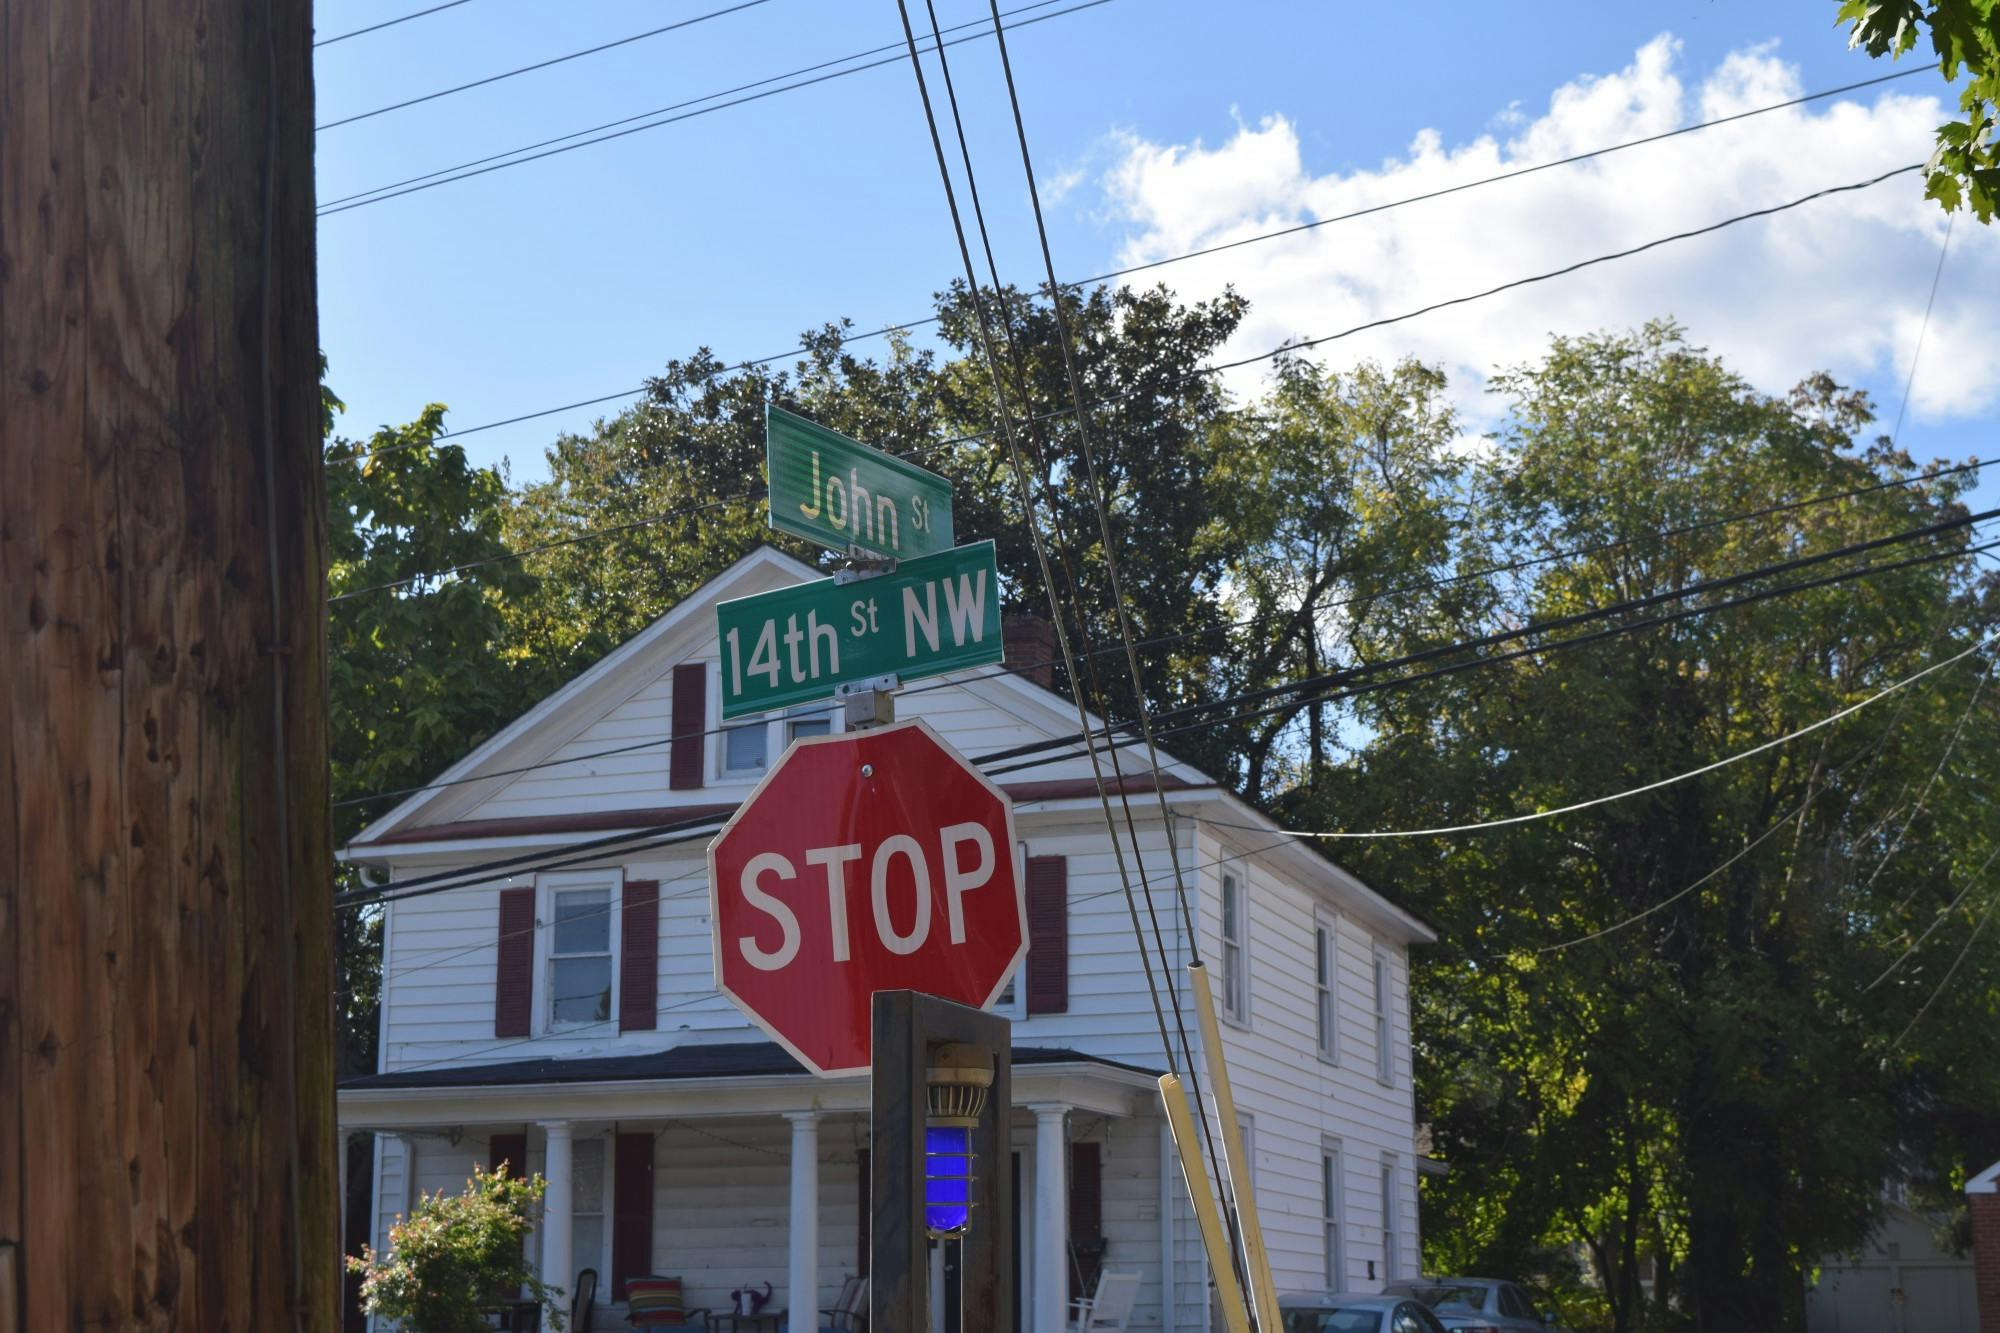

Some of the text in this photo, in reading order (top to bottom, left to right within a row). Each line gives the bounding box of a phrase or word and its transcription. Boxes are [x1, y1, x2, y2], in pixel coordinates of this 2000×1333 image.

[799, 451, 931, 550] John St
[726, 569, 987, 696] 14th St NW
[739, 822, 996, 971] STOP
